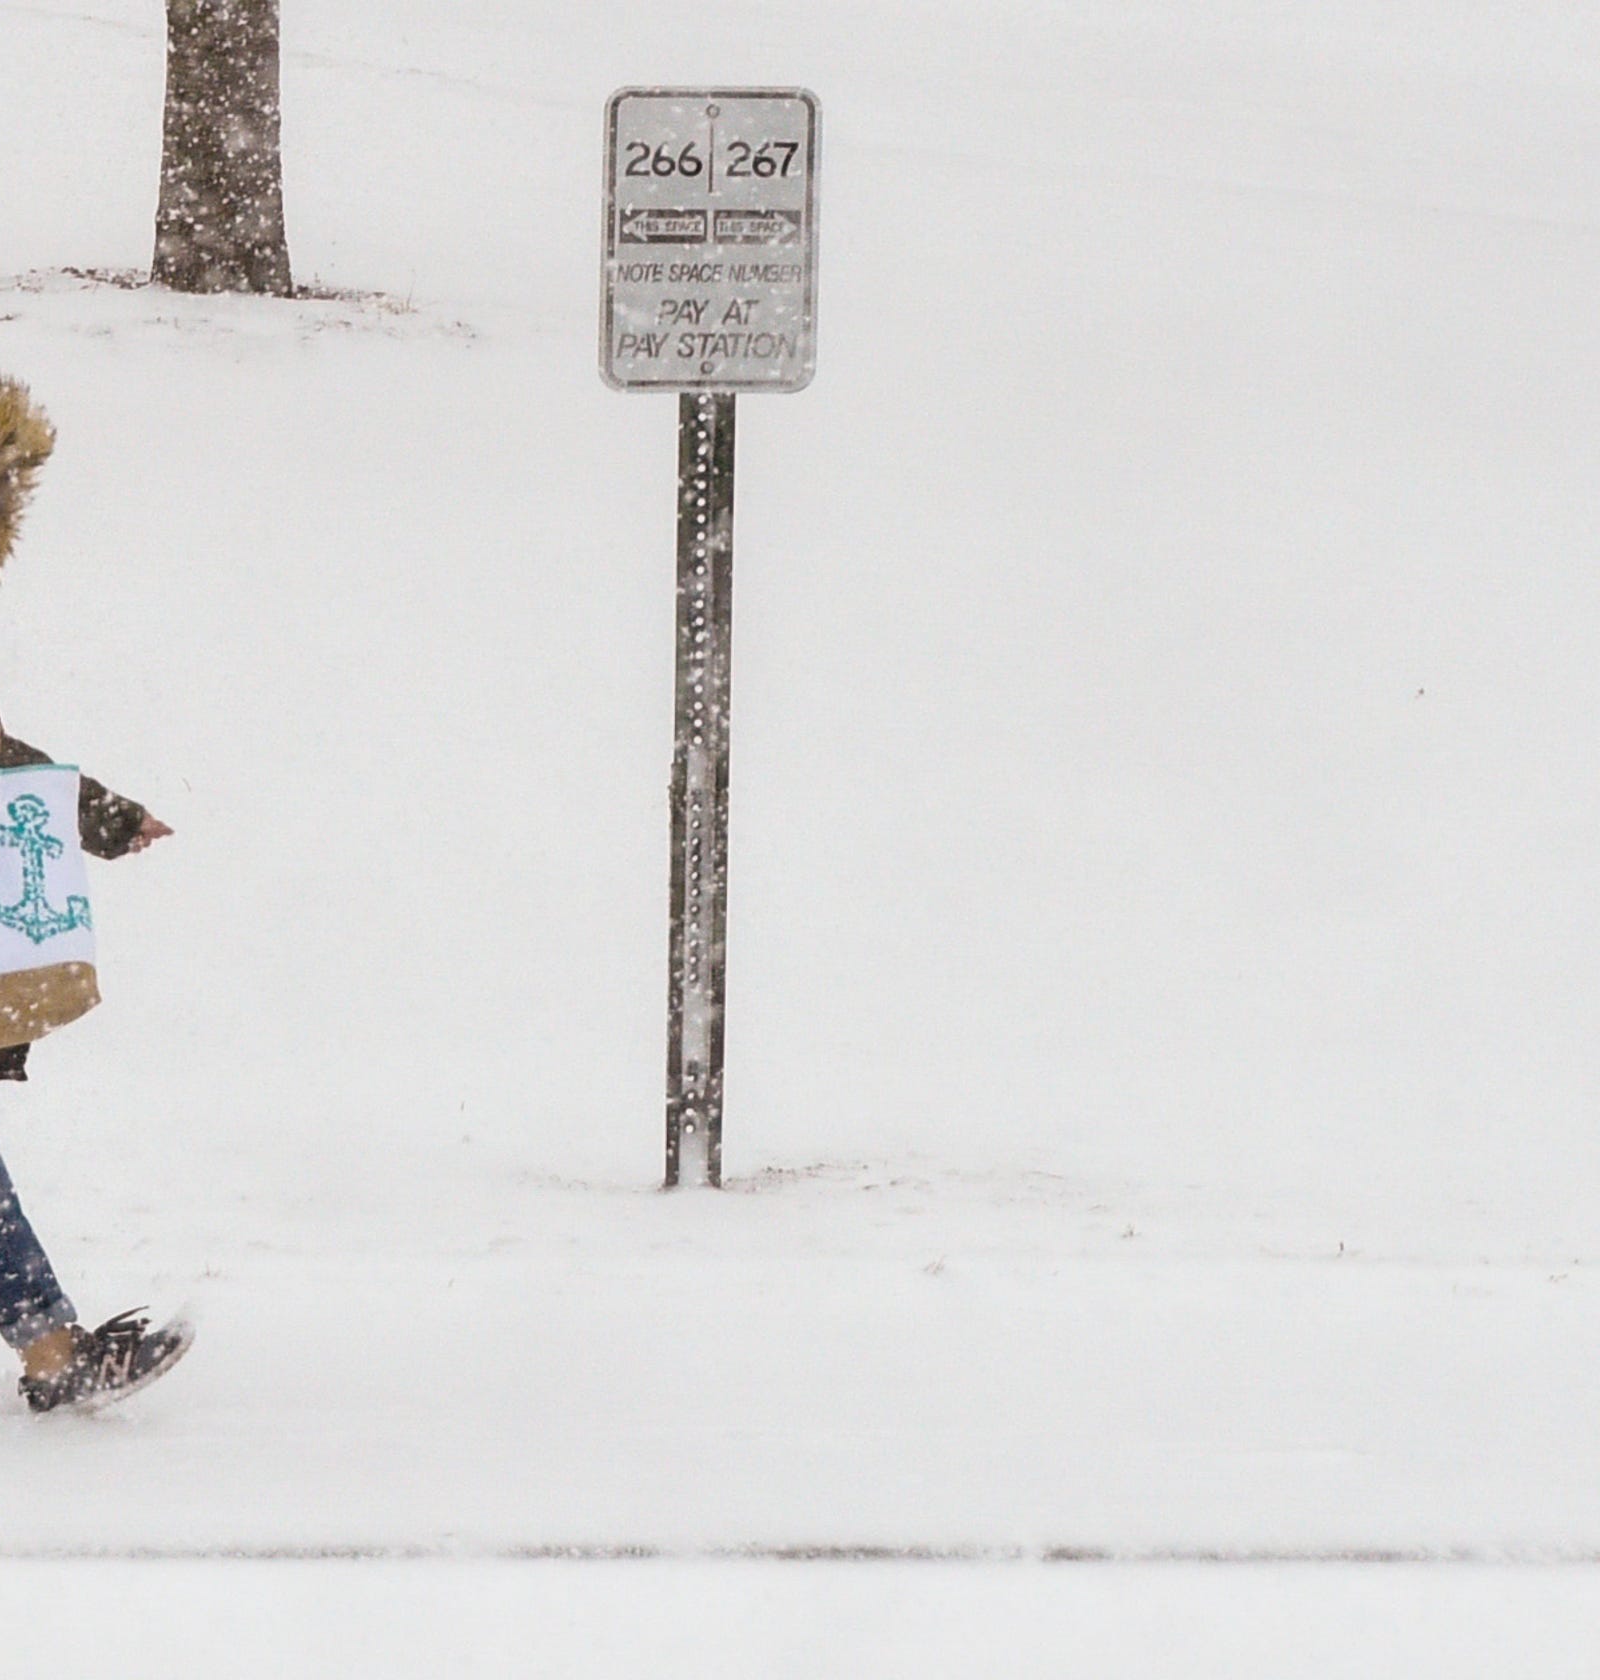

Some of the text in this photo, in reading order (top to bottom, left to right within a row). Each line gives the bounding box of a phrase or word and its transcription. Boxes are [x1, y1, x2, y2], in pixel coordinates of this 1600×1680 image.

[625, 141, 703, 177] 266
[726, 141, 799, 178] 267
[634, 219, 703, 233] THIS SPACE
[719, 220, 745, 233] THIS
[616, 263, 801, 284] NOTE SPACE NUMBER
[657, 298, 760, 326] PAY AT
[616, 331, 798, 359] PAY STATION
